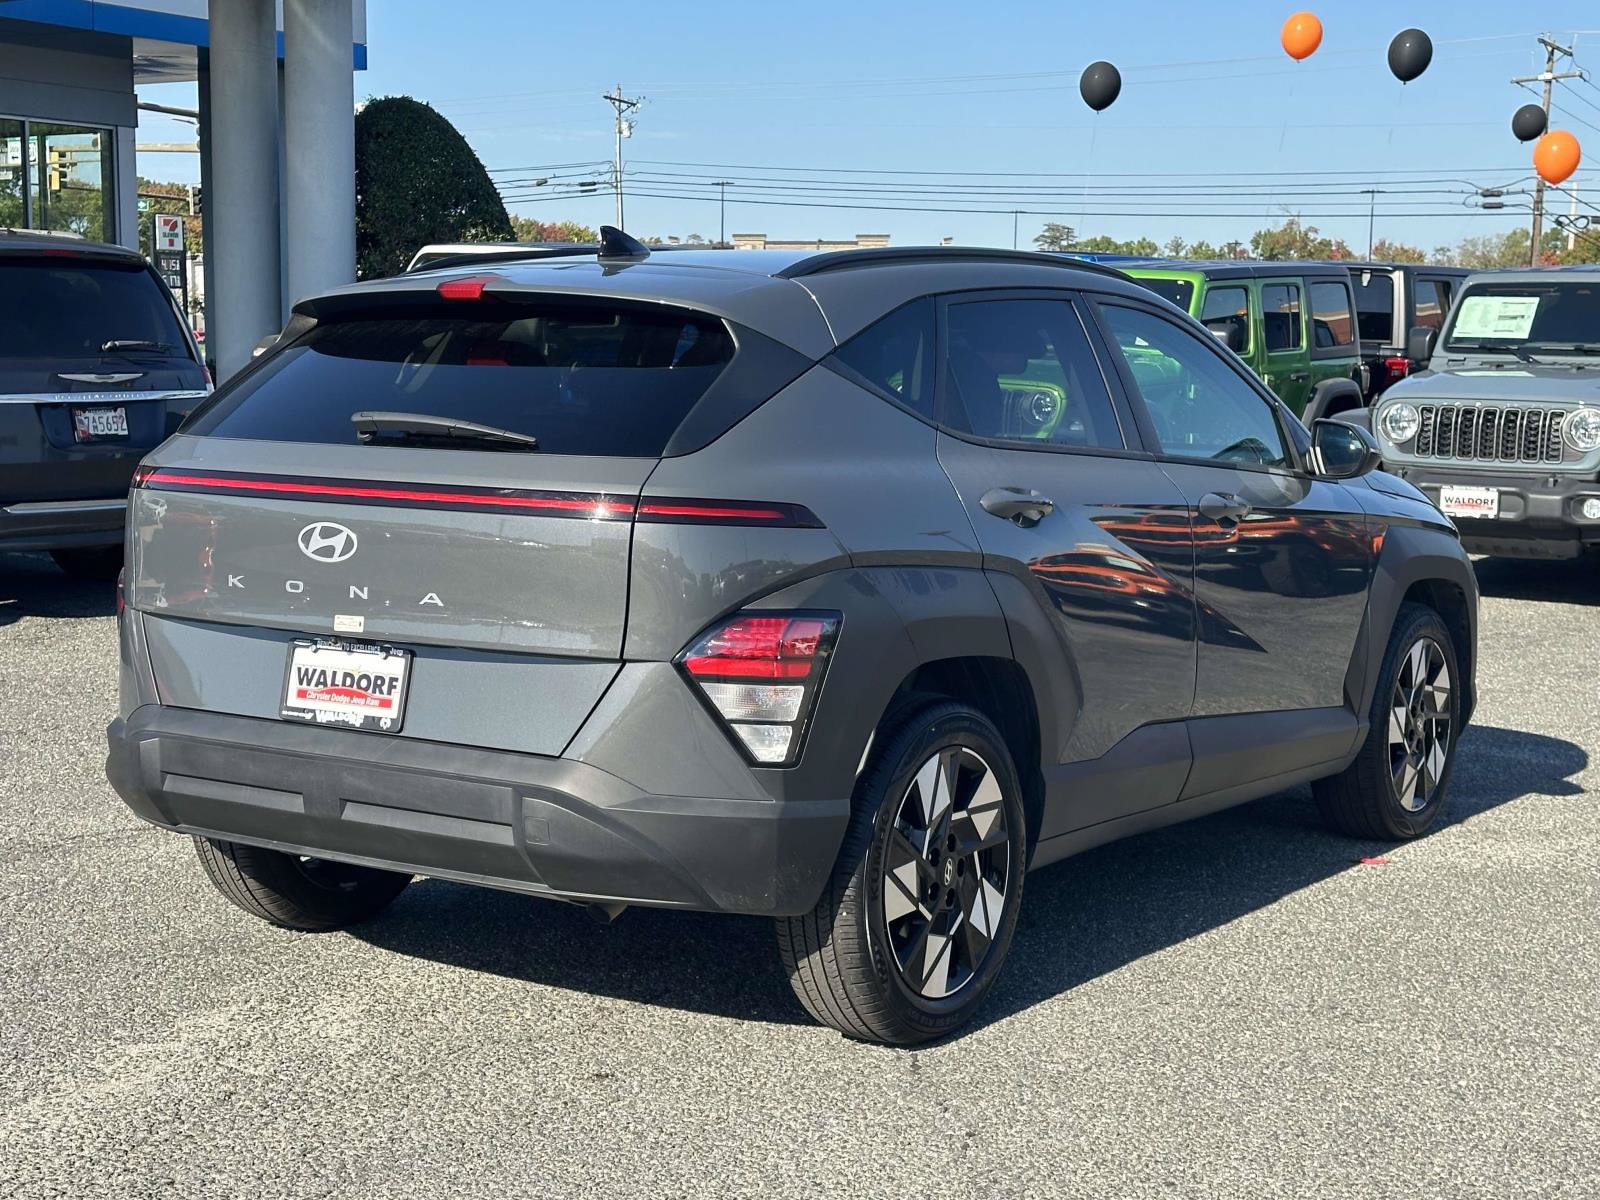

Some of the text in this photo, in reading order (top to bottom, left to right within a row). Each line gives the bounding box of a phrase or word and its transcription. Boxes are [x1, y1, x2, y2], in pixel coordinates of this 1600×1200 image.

[1444, 496, 1495, 506] WALDORF
[228, 574, 444, 607] KONA
[389, 647, 404, 656] Jeep
[296, 666, 399, 696] WALDORF
[306, 691, 380, 707] Chrysler Dodge Jeep Ram
